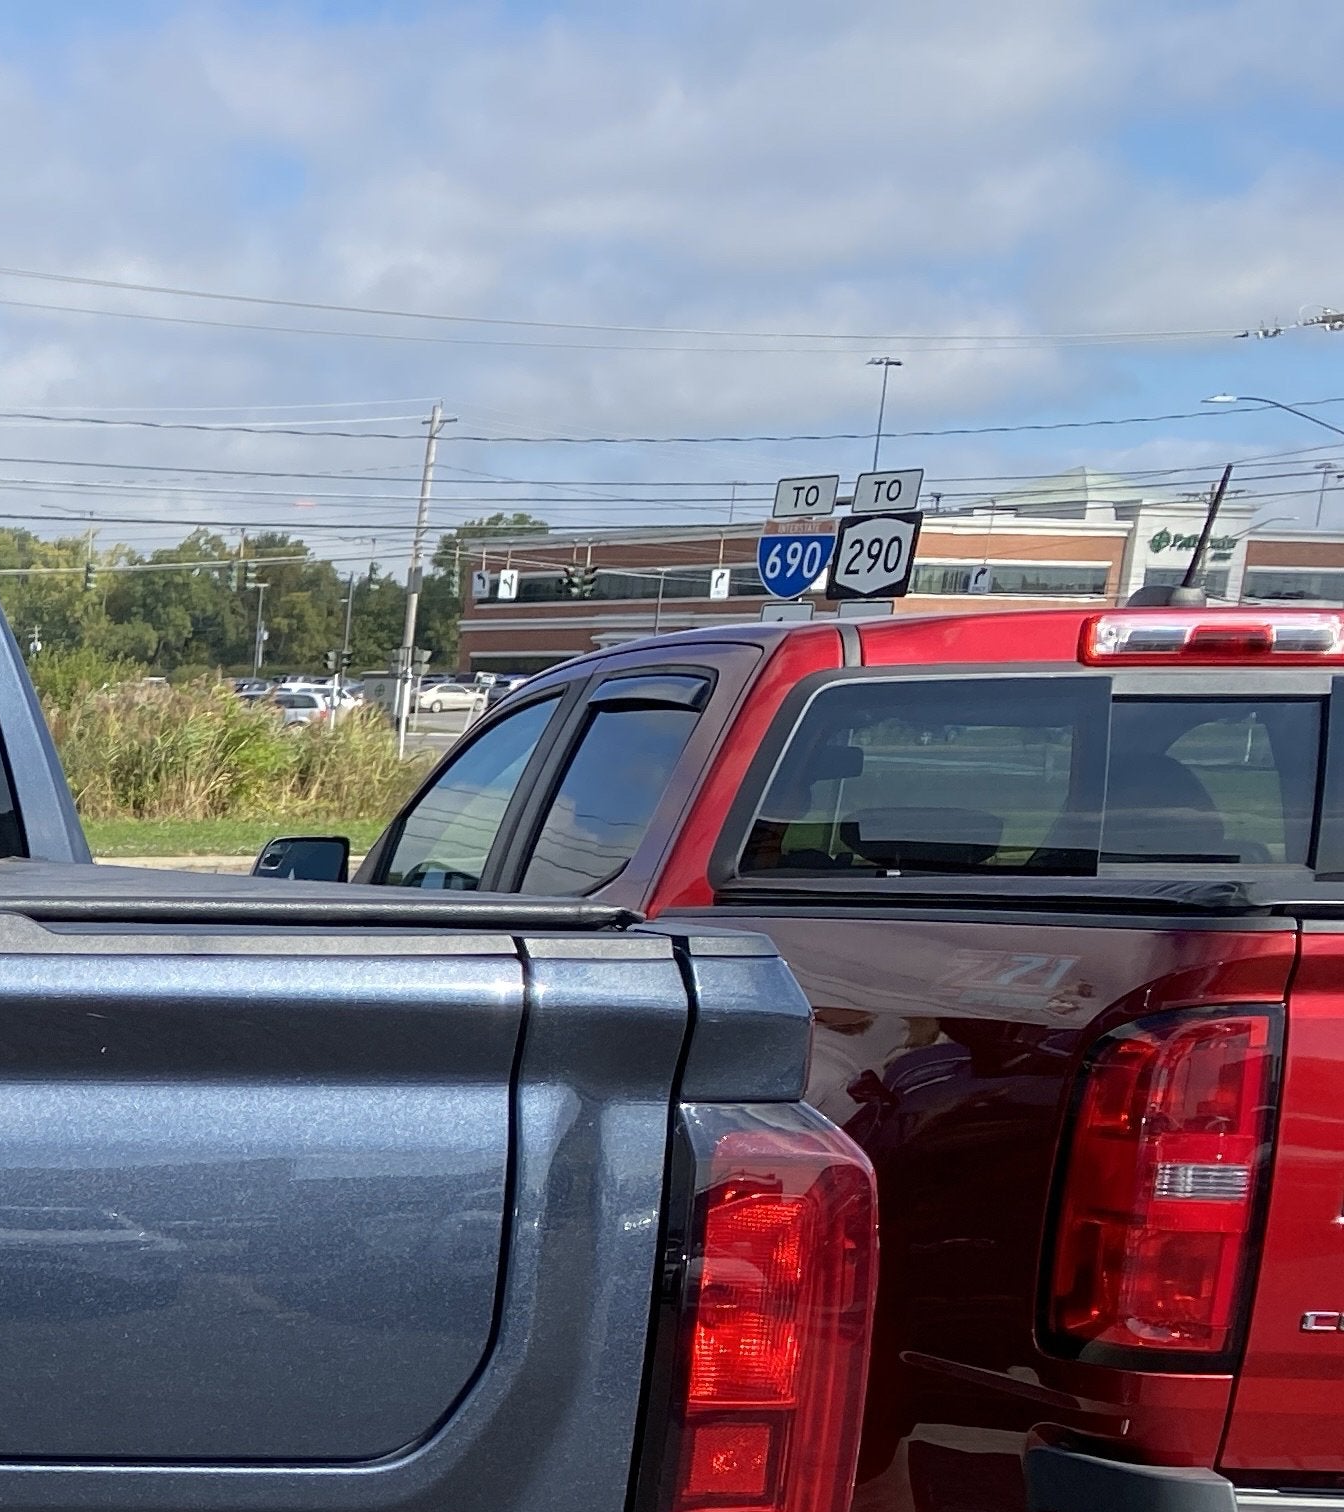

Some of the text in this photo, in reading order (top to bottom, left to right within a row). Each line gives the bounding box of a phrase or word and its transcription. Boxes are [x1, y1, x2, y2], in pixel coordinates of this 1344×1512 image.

[793, 485, 820, 508] TO
[873, 479, 902, 503] TO
[777, 522, 820, 534] INTERSTATE
[765, 541, 822, 579] 690
[844, 536, 903, 575] 290
[1301, 1311, 1344, 1331] C
